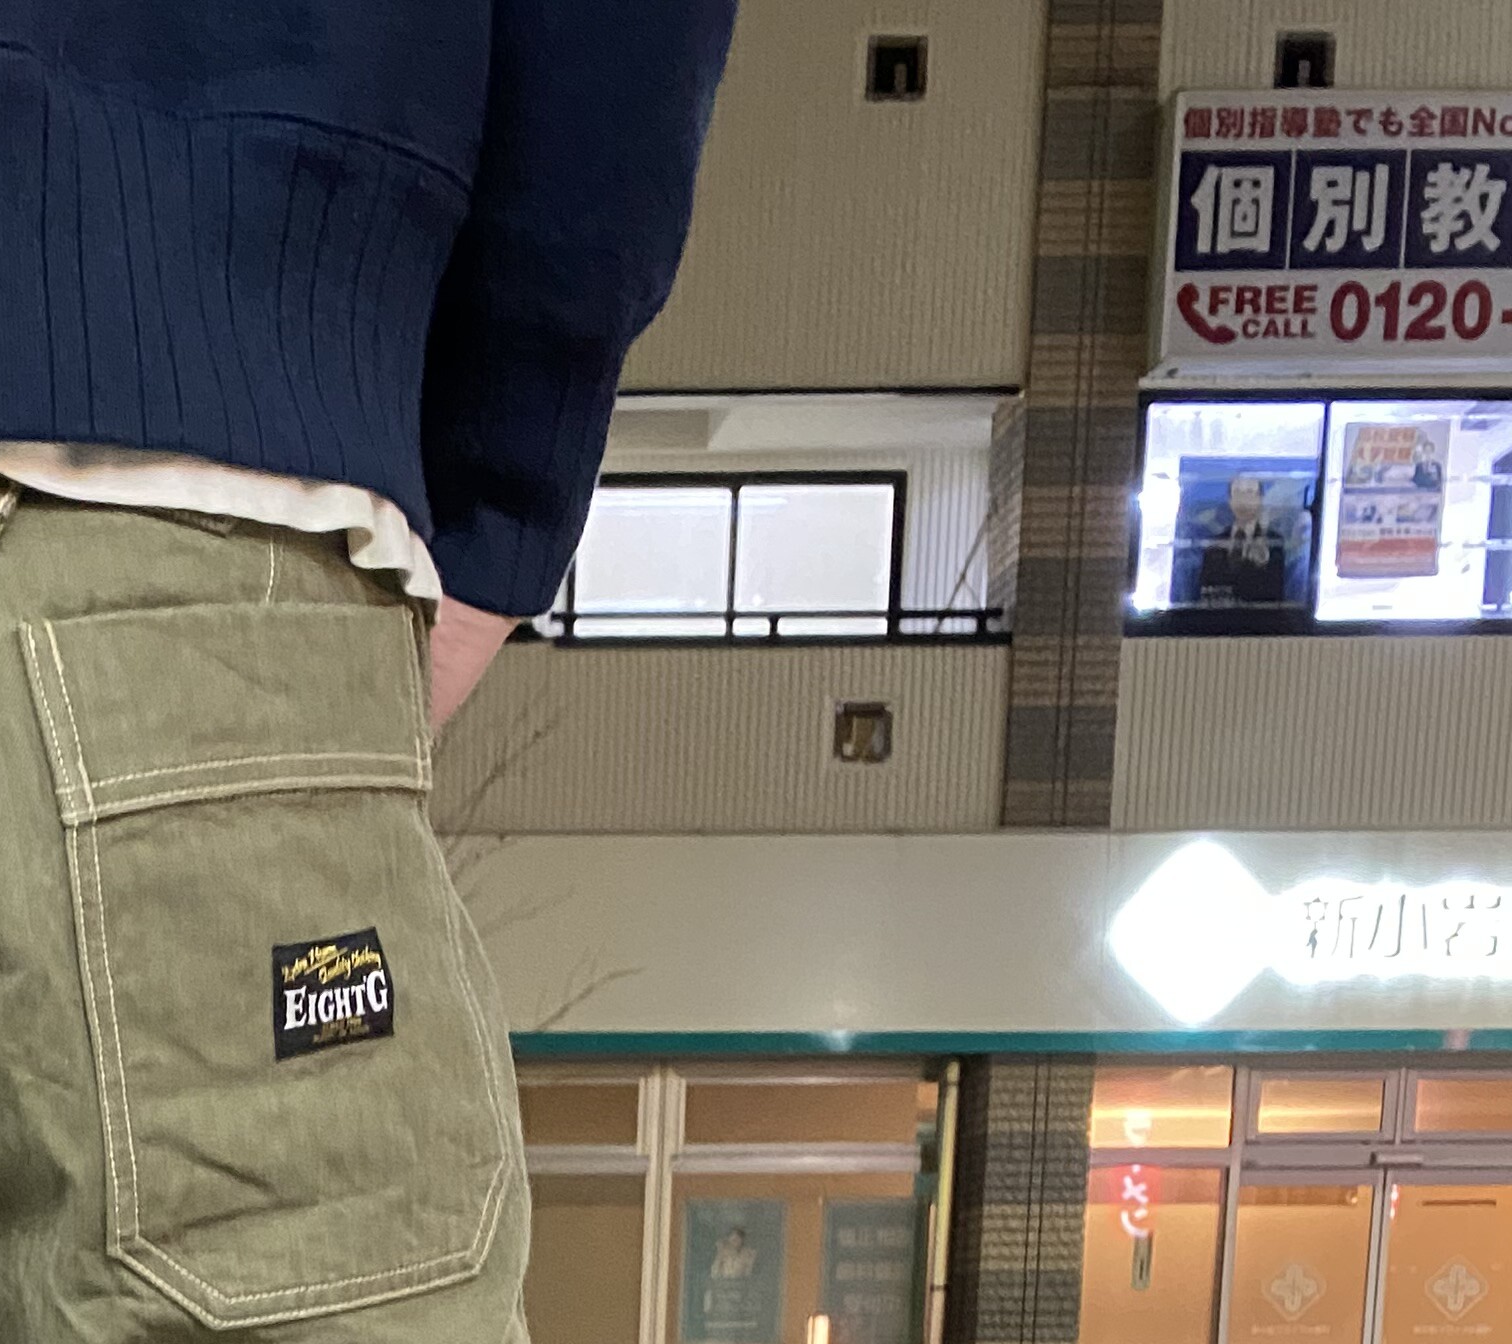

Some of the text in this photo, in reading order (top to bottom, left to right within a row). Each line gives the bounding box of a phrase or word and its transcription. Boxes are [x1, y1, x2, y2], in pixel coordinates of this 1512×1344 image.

[1191, 162, 1507, 253] 個別教
[1208, 284, 1318, 315] FREE
[1242, 318, 1316, 339] CALL
